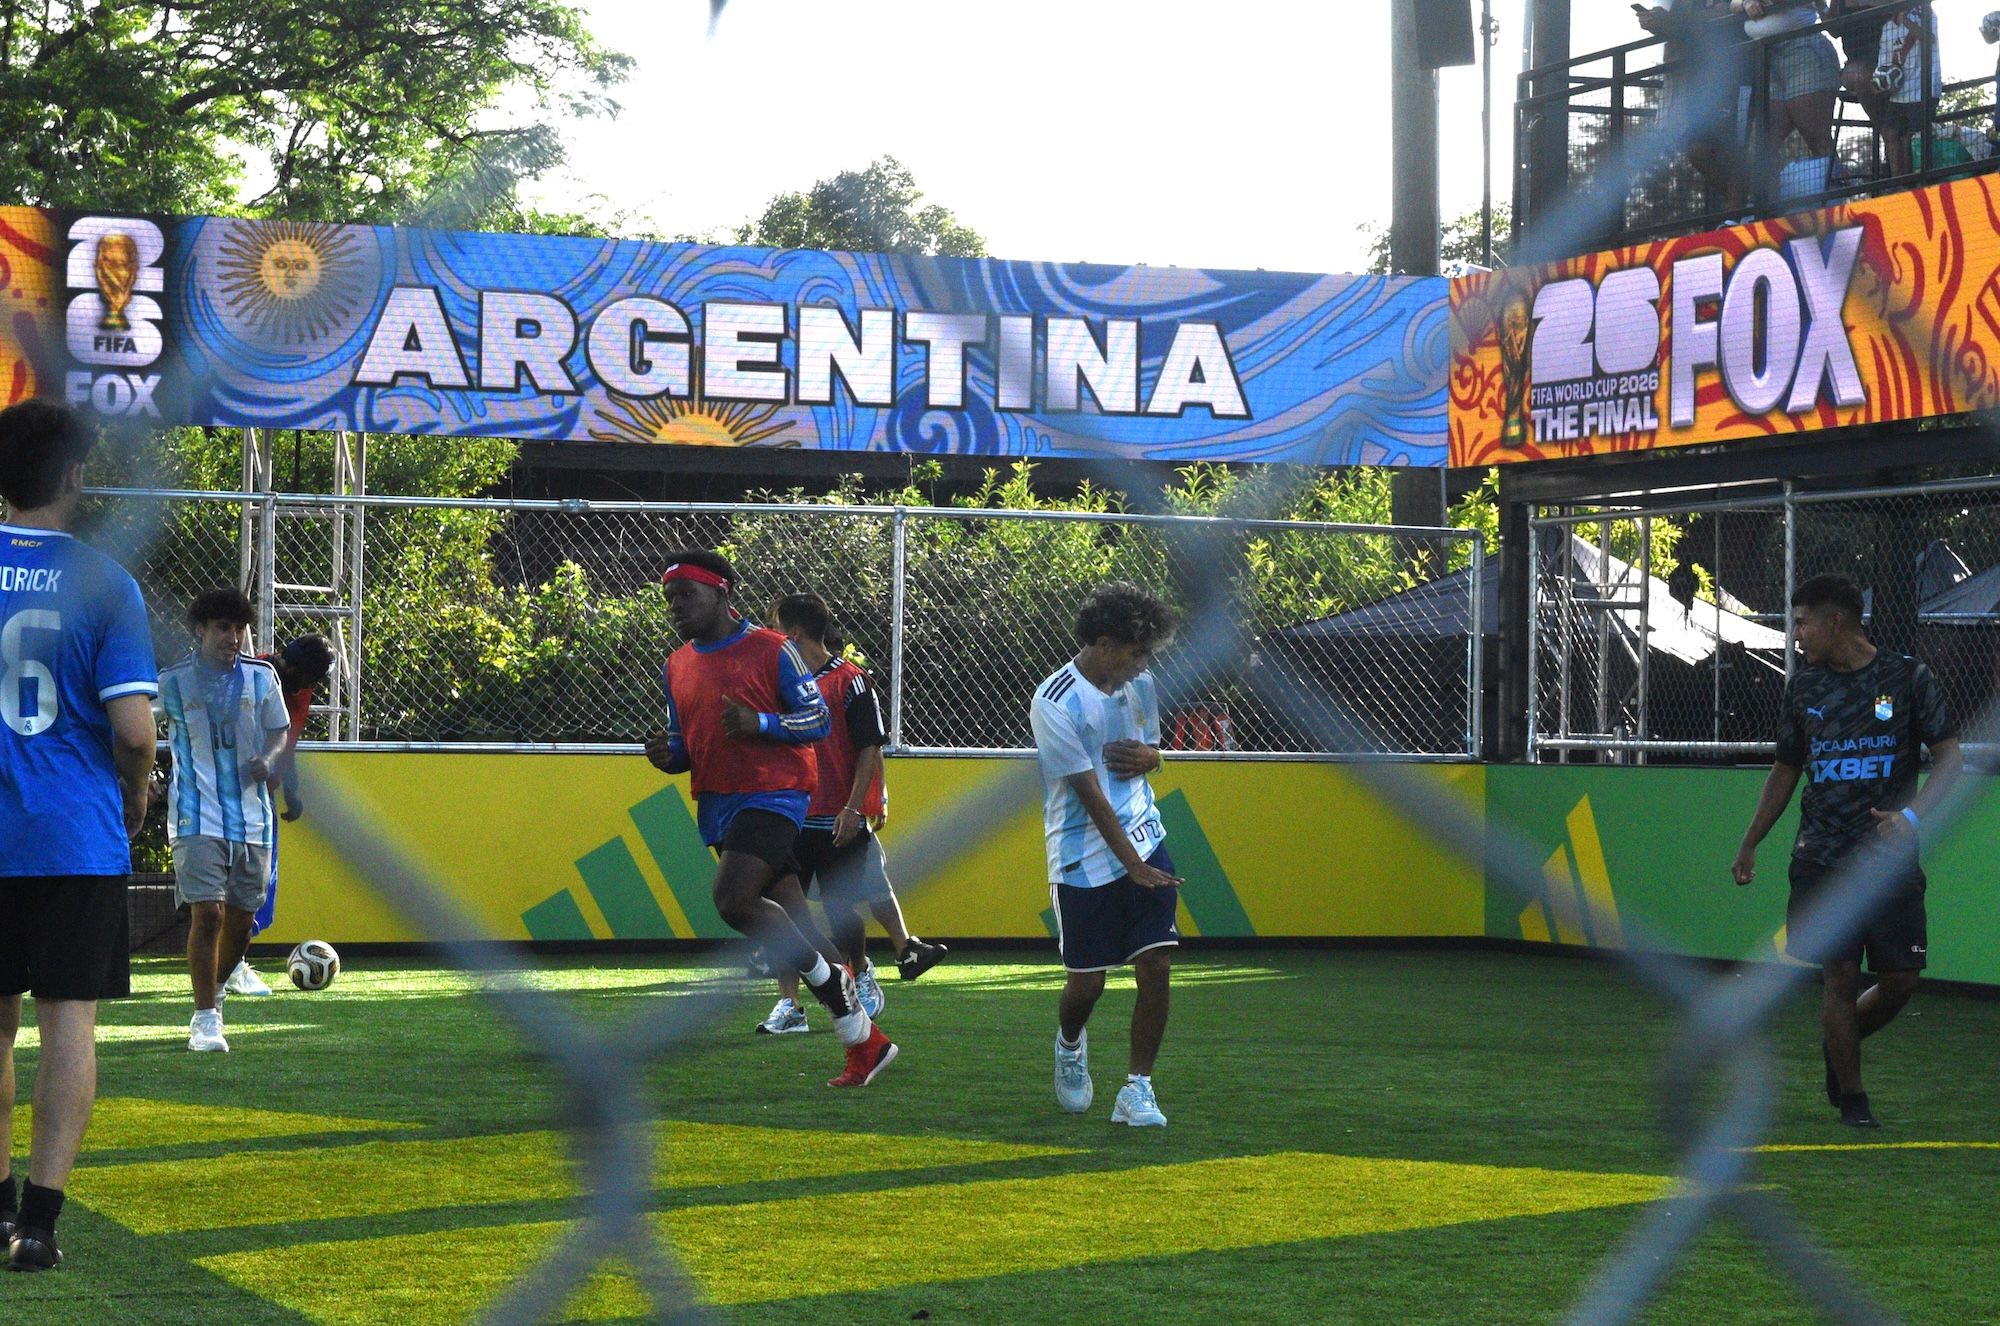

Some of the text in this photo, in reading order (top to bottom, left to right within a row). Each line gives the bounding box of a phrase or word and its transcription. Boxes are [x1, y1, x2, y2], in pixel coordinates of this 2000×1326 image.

[93, 335, 138, 354] FIFA
[1530, 266, 1660, 385] 26
[1670, 226, 1866, 429] FOX
[352, 284, 1248, 420] ARGENTINA
[65, 371, 161, 418] FOX
[1531, 372, 1658, 406] FIFA WORLD CUP 2026
[1531, 395, 1659, 443] THE FINAL
[1, 609, 62, 736] 6
[210, 719, 237, 751] 10
[1821, 735, 1897, 753] CAJA PIURA
[1811, 754, 1896, 784] 1XBET
